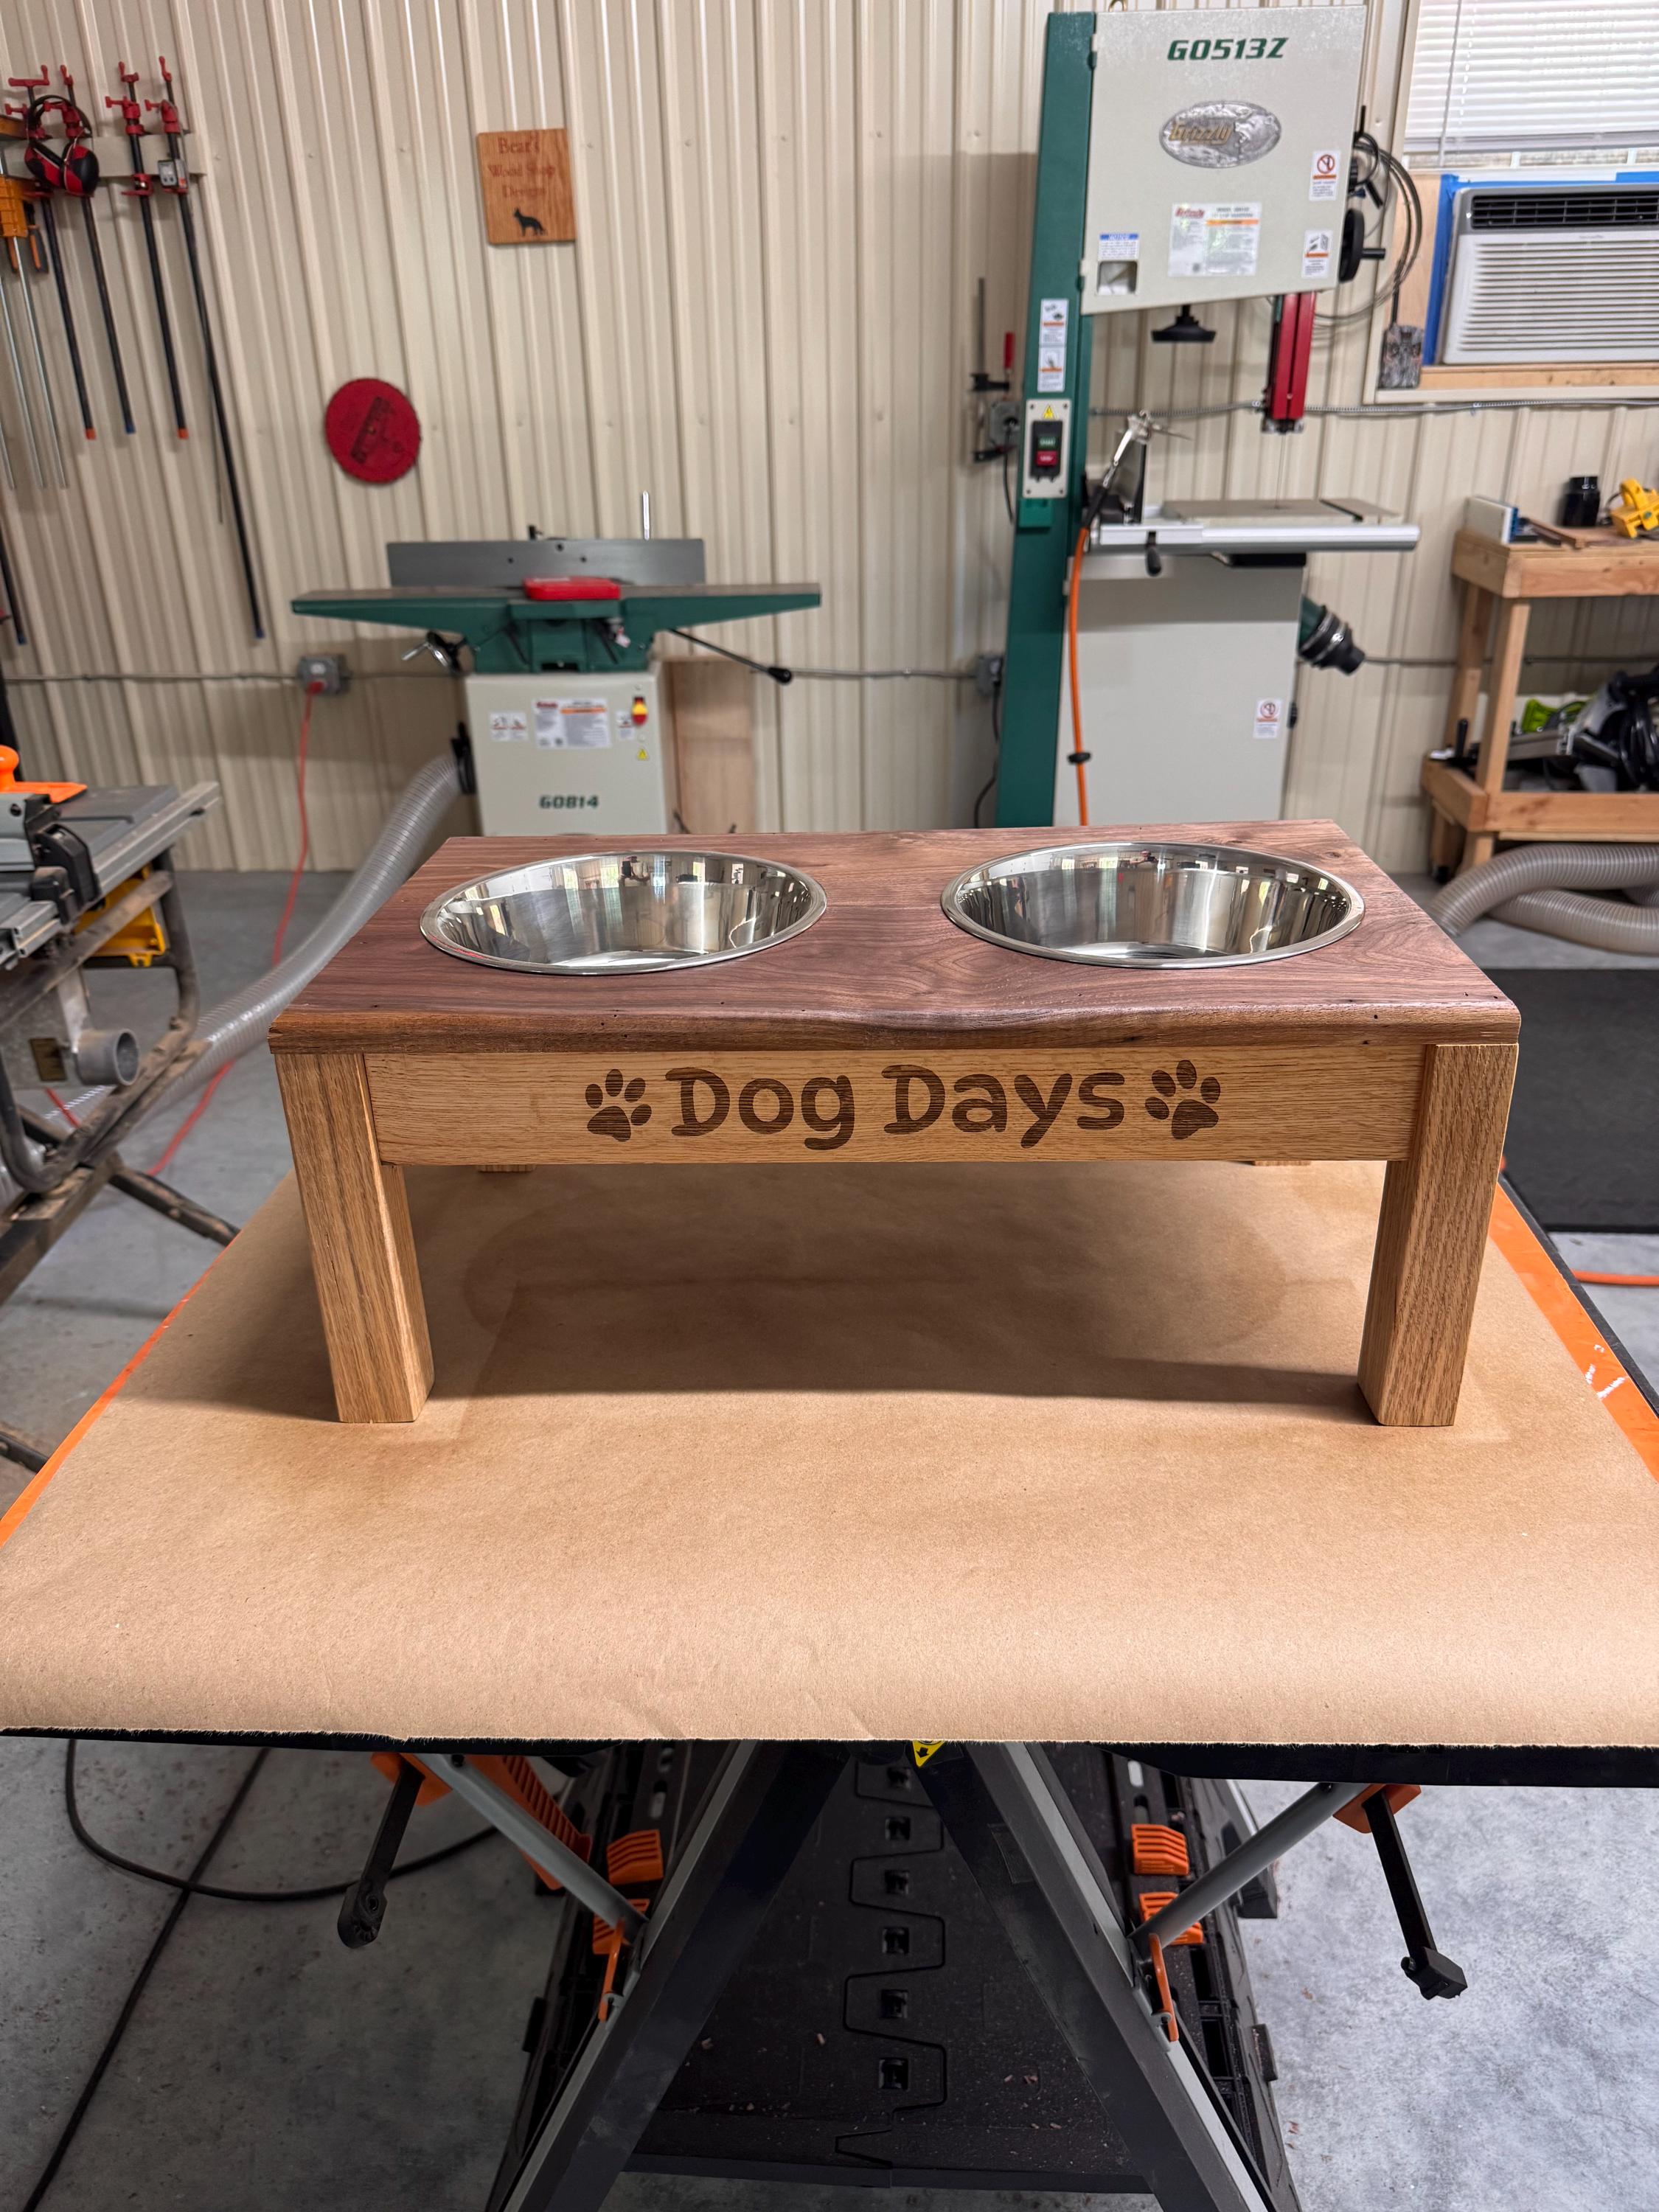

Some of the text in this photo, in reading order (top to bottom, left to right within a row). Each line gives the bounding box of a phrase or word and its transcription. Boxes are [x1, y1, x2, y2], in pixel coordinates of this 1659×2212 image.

[1167, 37, 1289, 60] G0513Z
[1169, 119, 1234, 146] Grizzly
[665, 1064, 1125, 1150] Dog Days
